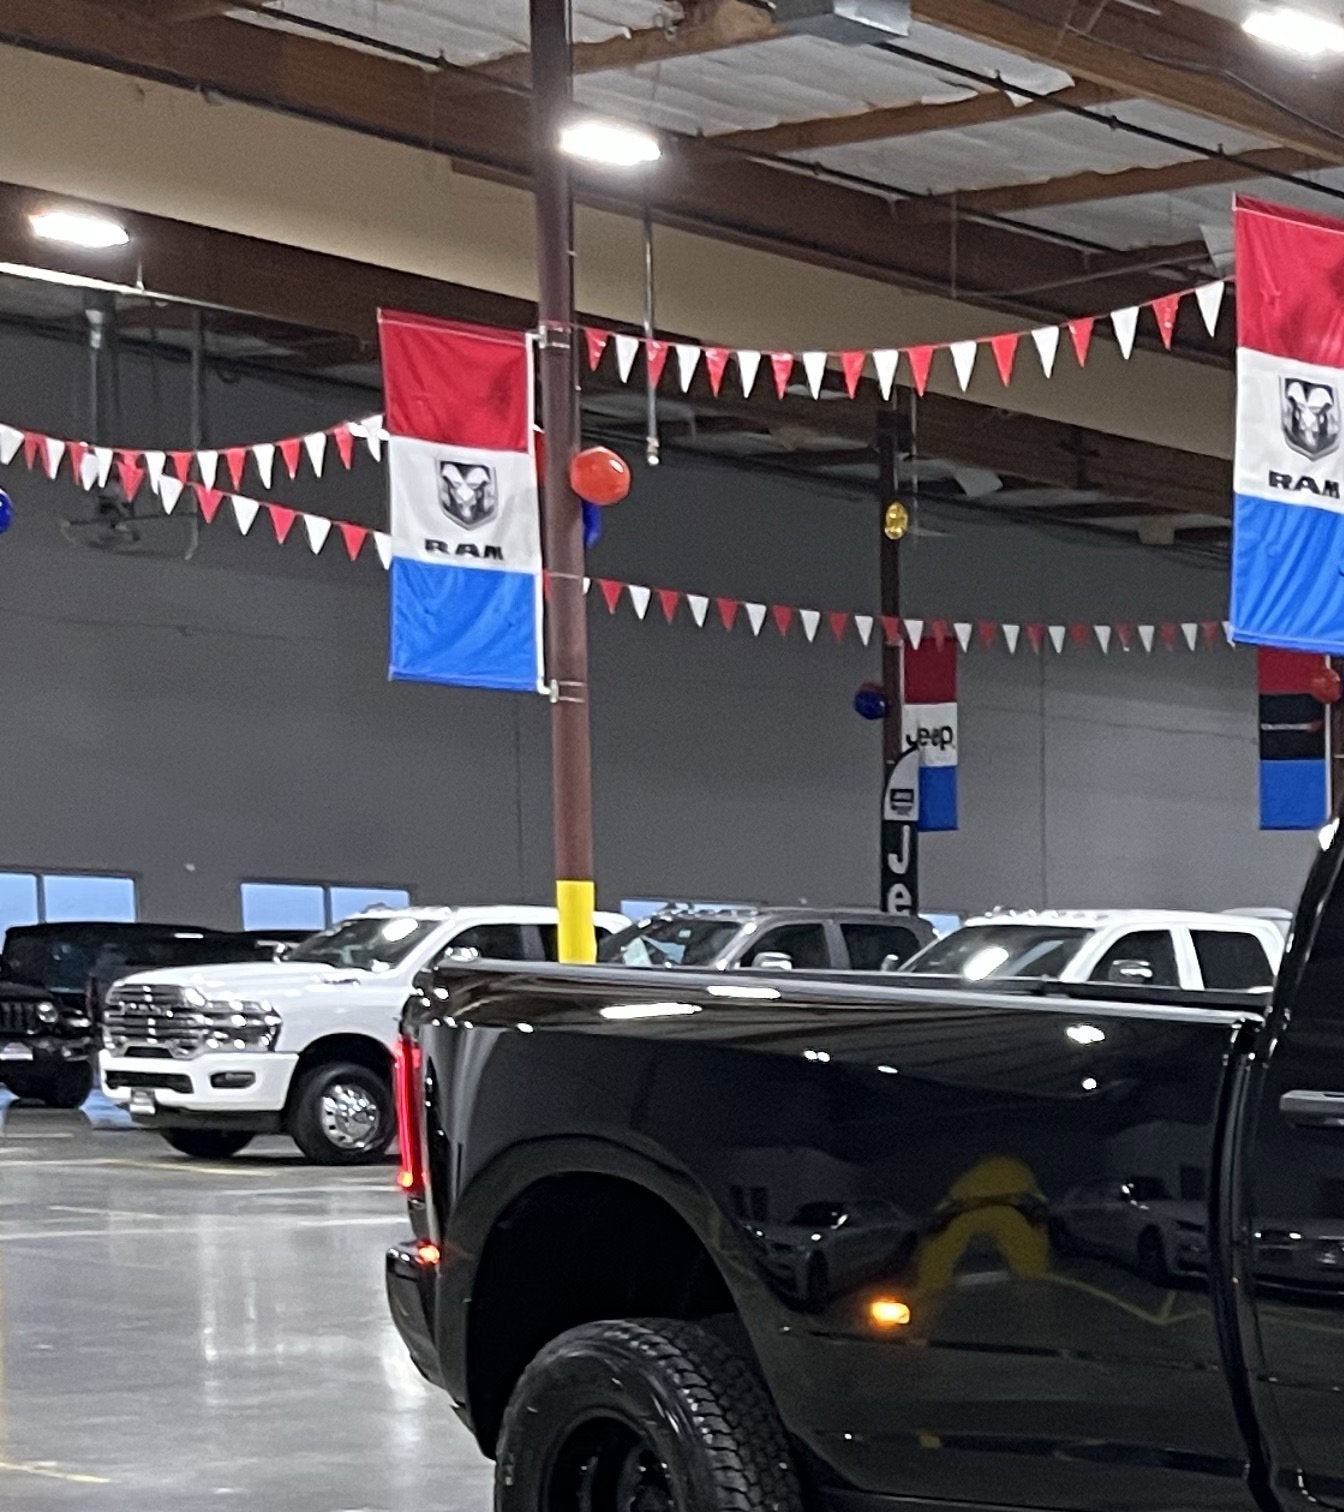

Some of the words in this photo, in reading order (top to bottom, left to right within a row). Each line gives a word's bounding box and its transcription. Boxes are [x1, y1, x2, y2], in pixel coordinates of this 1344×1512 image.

[1268, 470, 1340, 499] RAM
[424, 538, 505, 561] RAM
[905, 725, 954, 751] Jeep
